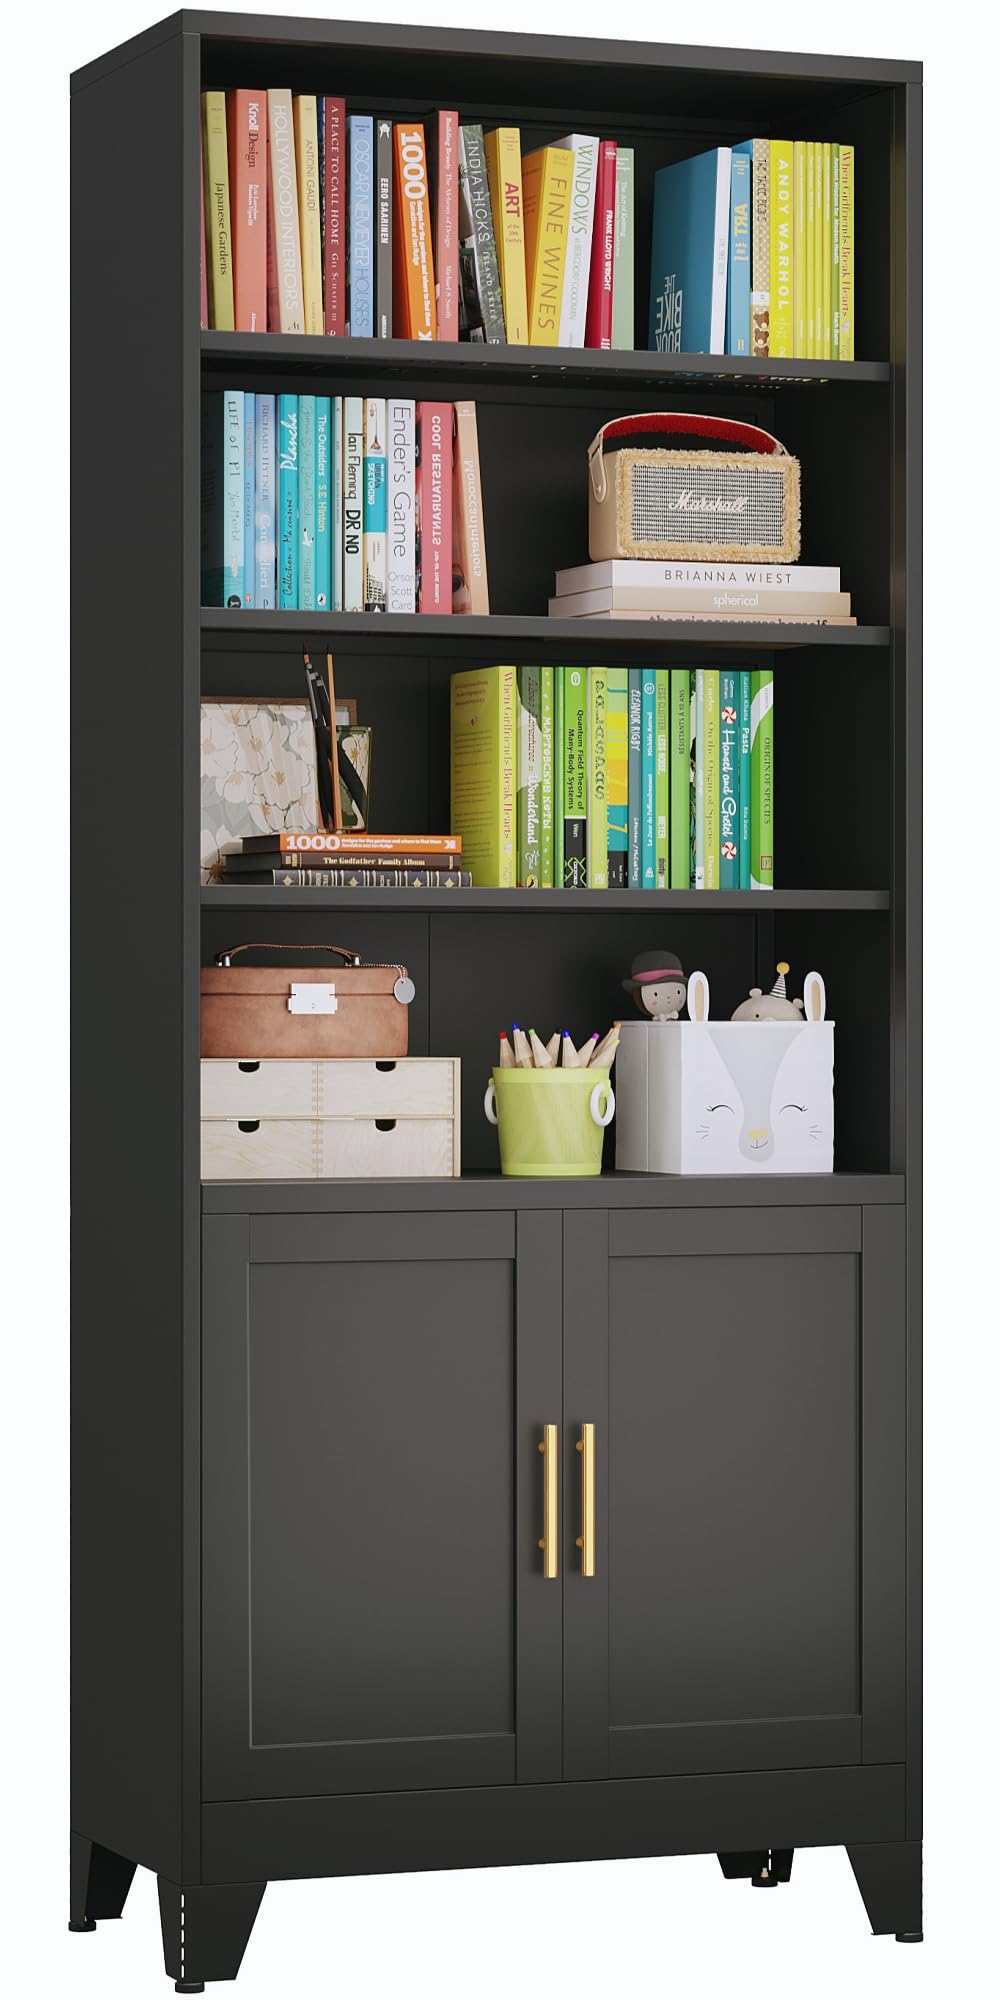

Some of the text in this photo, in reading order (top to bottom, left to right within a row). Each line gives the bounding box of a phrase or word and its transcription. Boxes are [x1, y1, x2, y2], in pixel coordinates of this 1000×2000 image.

[331, 105, 339, 113] A
[245, 103, 259, 168] Knoll Design
[331, 116, 339, 152] PLACE
[443, 117, 452, 146] Building
[305, 139, 315, 178] ANTONI
[331, 156, 339, 174] TO
[354, 139, 370, 192] OSCAR
[400, 131, 425, 199] 1000
[443, 147, 452, 170] Beauty
[331, 176, 339, 206] CALL
[444, 173, 452, 186] The
[467, 140, 490, 242] INDIA HICKS
[571, 144, 593, 236] WINDOWS
[274, 105, 299, 311] HOLLYWOOD INTERIORS
[380, 178, 389, 244] EERO SAARINEN
[505, 182, 520, 217] ART
[215, 182, 228, 275] Japanese Gardens
[331, 209, 339, 246] HOME
[354, 194, 370, 266] NIEMEYER
[443, 225, 452, 249] Design
[444, 216, 452, 224] of
[778, 159, 789, 310] ANDY WARHOL
[841, 151, 851, 317] When Girlfriends Break Hearts
[482, 251, 493, 287] ISLAND
[538, 177, 567, 330] FINE WINES
[603, 209, 613, 291] FRANK LLOYD WRIGHT
[445, 264, 453, 290] Michael
[354, 268, 370, 327] HOUSES
[445, 299, 453, 319] Smith
[227, 400, 241, 476] LIFE PI
[261, 404, 269, 501] RICHARD HYTNER
[279, 413, 297, 471] Plancha
[318, 415, 327, 477] The Outsiders
[343, 432, 363, 499] Ian Fleming
[367, 463, 375, 505] SKETCHING
[393, 406, 411, 557] Ender's Game
[318, 501, 327, 533] Hinton
[668, 490, 749, 513] Marshall
[345, 509, 360, 554] DR NO
[391, 586, 413, 596] Scott
[665, 570, 792, 584] BRIANNA WIEST
[713, 593, 760, 608] spherical
[576, 709, 584, 747] Quantum
[631, 689, 641, 751] ELEANOR RIGBY
[708, 722, 715, 735] On
[502, 671, 513, 839] When Girlfriends Break Hearts
[742, 727, 750, 754] Pasta
[566, 728, 575, 810] Many-Body Systems
[576, 772, 584, 798] Theory
[705, 760, 715, 794] Origin
[720, 729, 737, 838] Hansel and Gretel
[763, 737, 771, 825] ORIGIN OF SPECIES
[527, 774, 540, 845] Wonderland
[577, 801, 584, 810] of
[708, 795, 715, 805] of
[286, 835, 341, 850] 1000
[705, 808, 715, 848] Species
[339, 857, 376, 865] Godfather
[378, 858, 401, 866] Family
